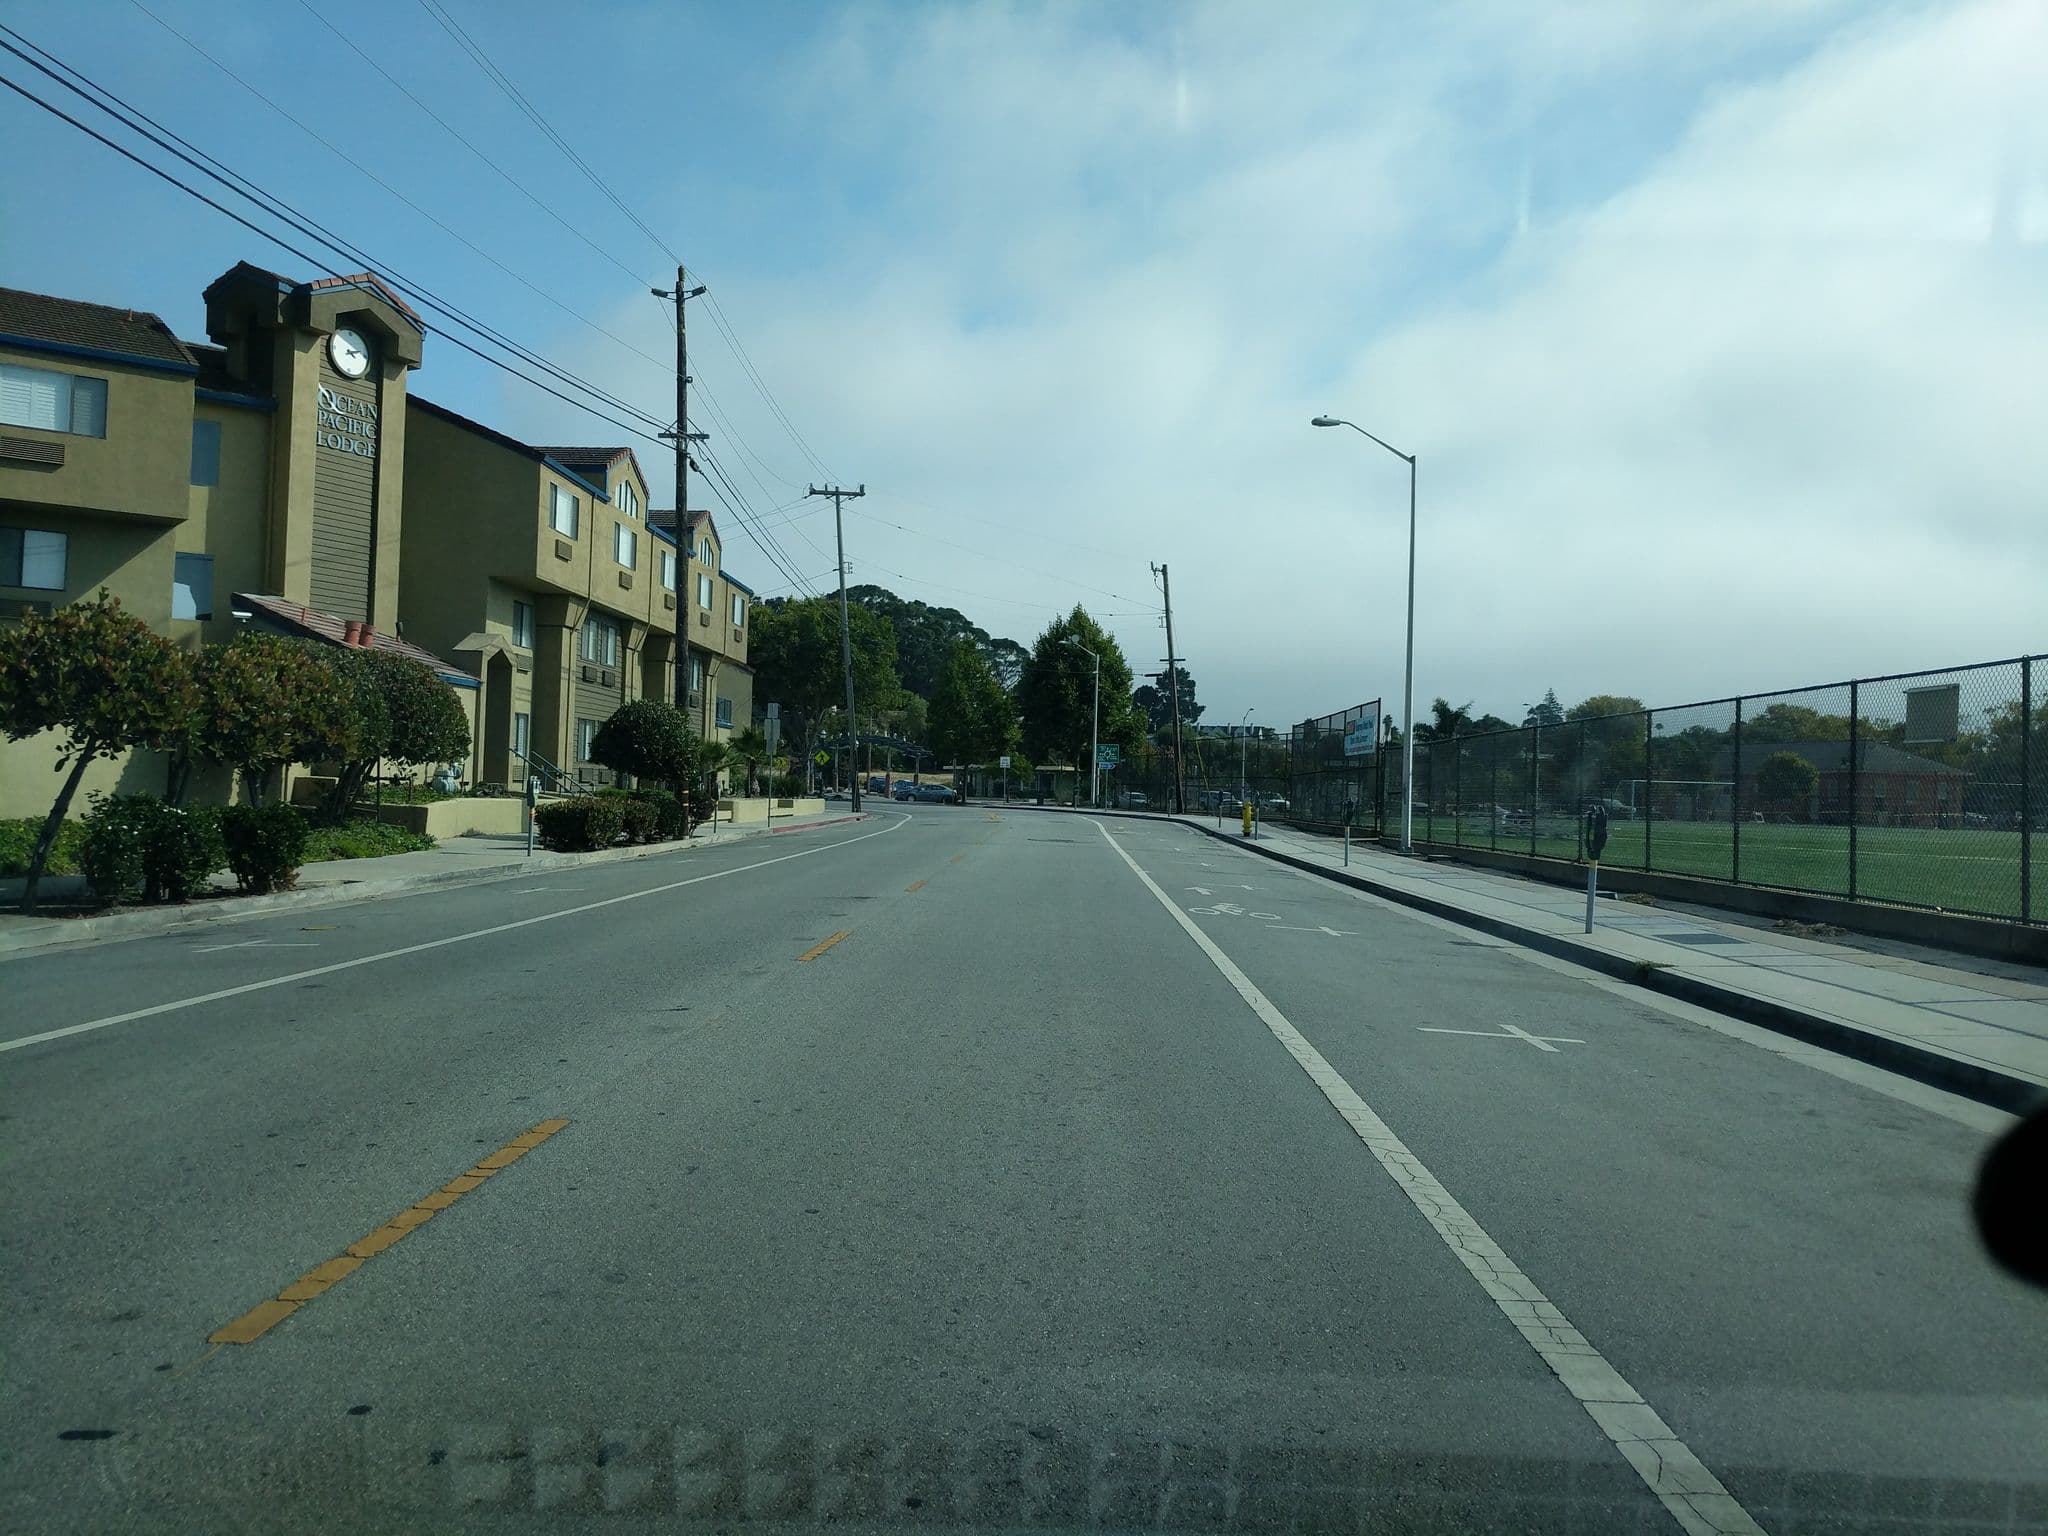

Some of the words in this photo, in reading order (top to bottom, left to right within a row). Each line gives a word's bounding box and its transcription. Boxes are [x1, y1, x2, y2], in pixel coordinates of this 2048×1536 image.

[318, 385, 377, 419] OCEAN
[318, 410, 377, 439] PACIFIC
[317, 430, 376, 458] LODGE
